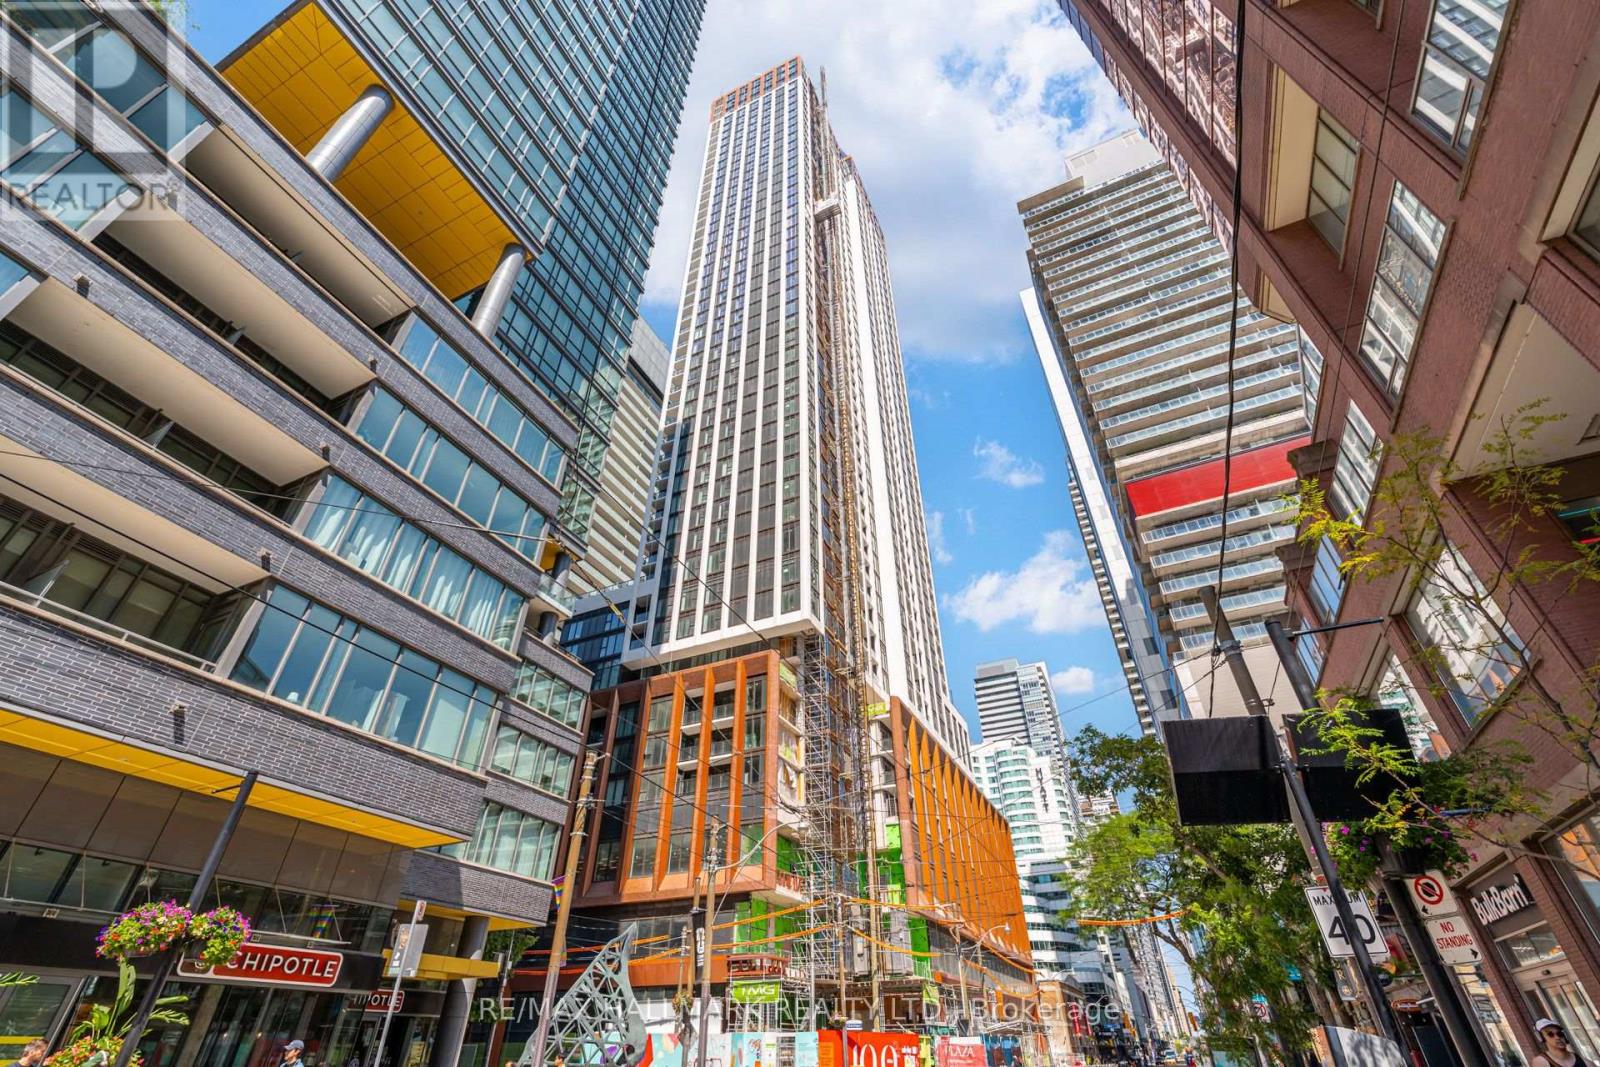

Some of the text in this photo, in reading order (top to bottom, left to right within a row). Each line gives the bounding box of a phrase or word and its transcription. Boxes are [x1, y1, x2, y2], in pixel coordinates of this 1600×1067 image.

[1035, 768, 1049, 813] HYATT
[1312, 893, 1362, 906] MAXUM
[1328, 914, 1376, 945] 40
[1440, 921, 1455, 934] NO
[1436, 934, 1474, 950] STANDING
[226, 950, 338, 979] CHIPOTLE
